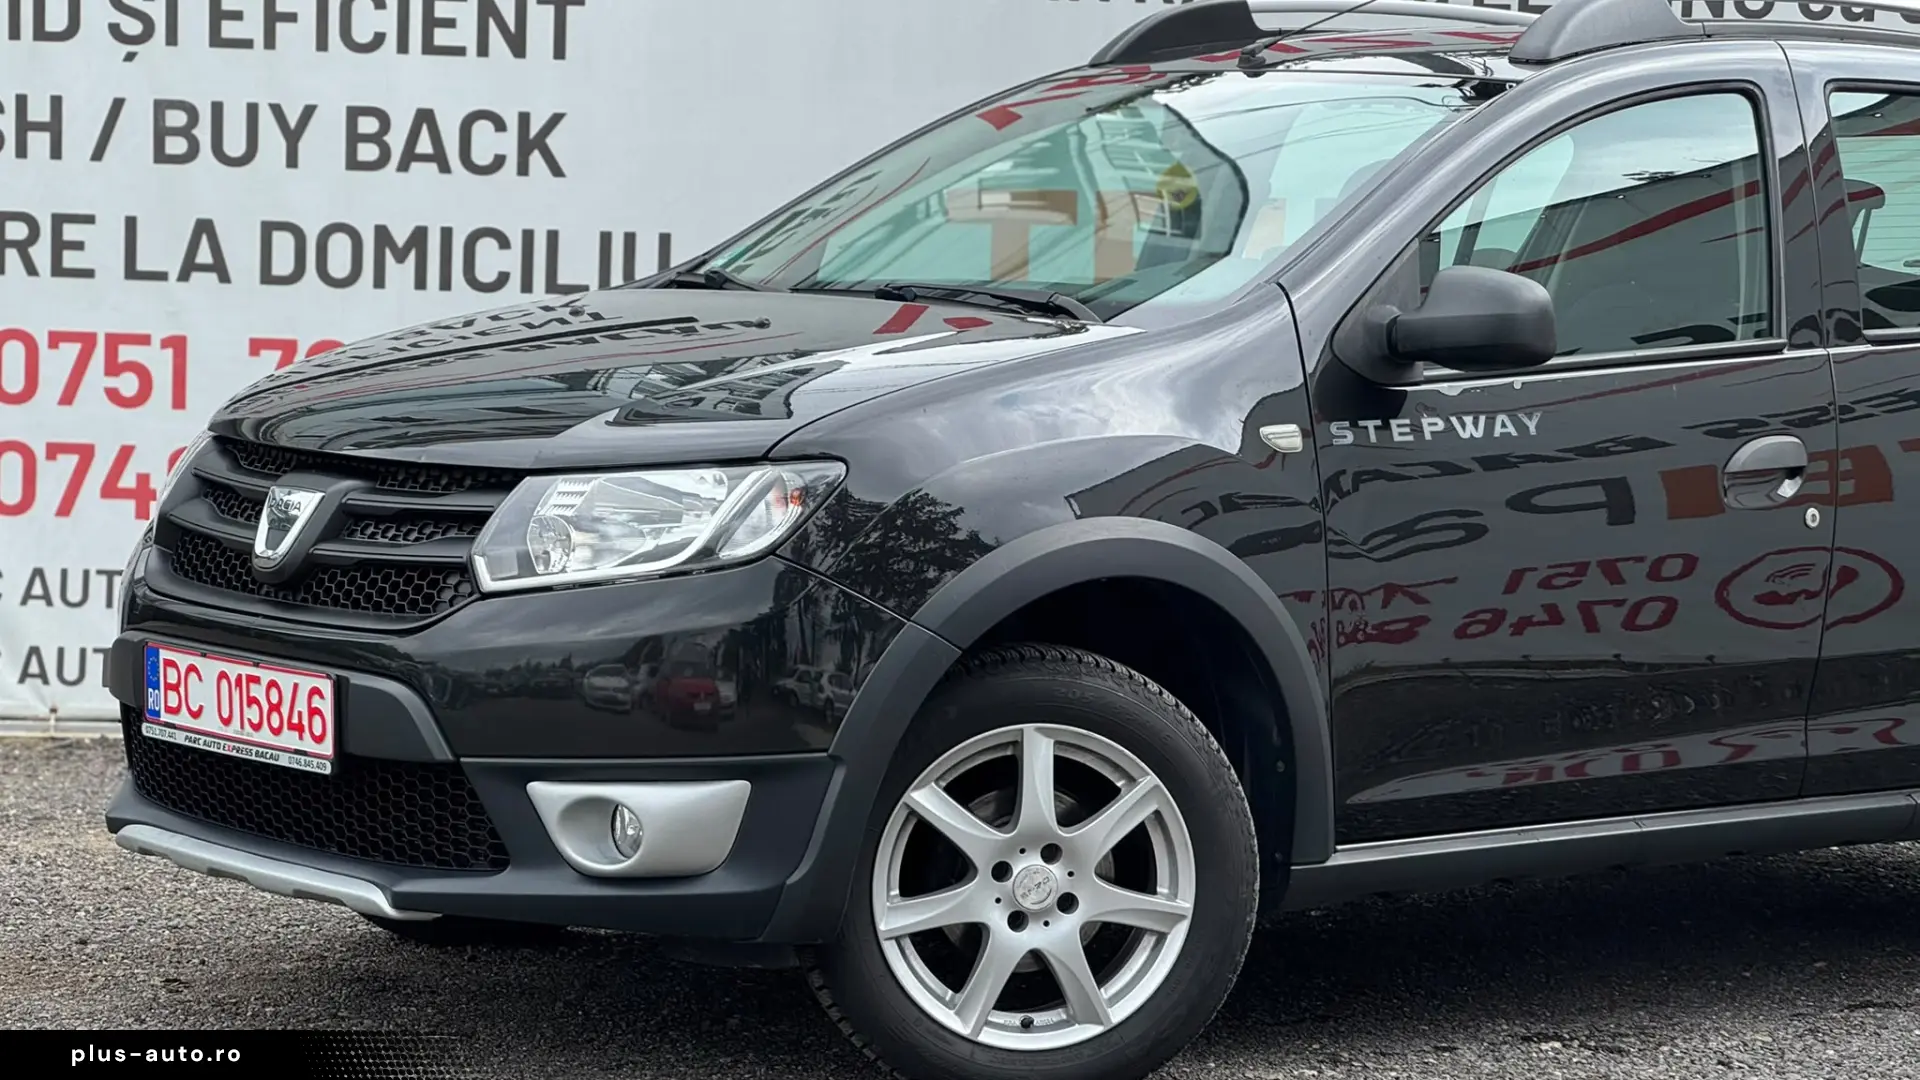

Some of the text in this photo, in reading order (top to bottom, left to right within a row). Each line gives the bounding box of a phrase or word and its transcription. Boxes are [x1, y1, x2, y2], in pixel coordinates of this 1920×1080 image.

[207, 0, 585, 60] EFICIENT
[0, 94, 567, 178] H / BUY BACK
[123, 215, 232, 284] LA
[0, 328, 188, 410] 0751
[1330, 411, 1544, 446] STEPWAY
[0, 440, 188, 521] 074
[19, 566, 124, 609] AUT
[148, 687, 160, 712] RO
[162, 657, 327, 744] BC 015846
[184, 734, 202, 745] PARC
[202, 739, 221, 750] AUTO
[222, 743, 253, 757] EXPRESS
